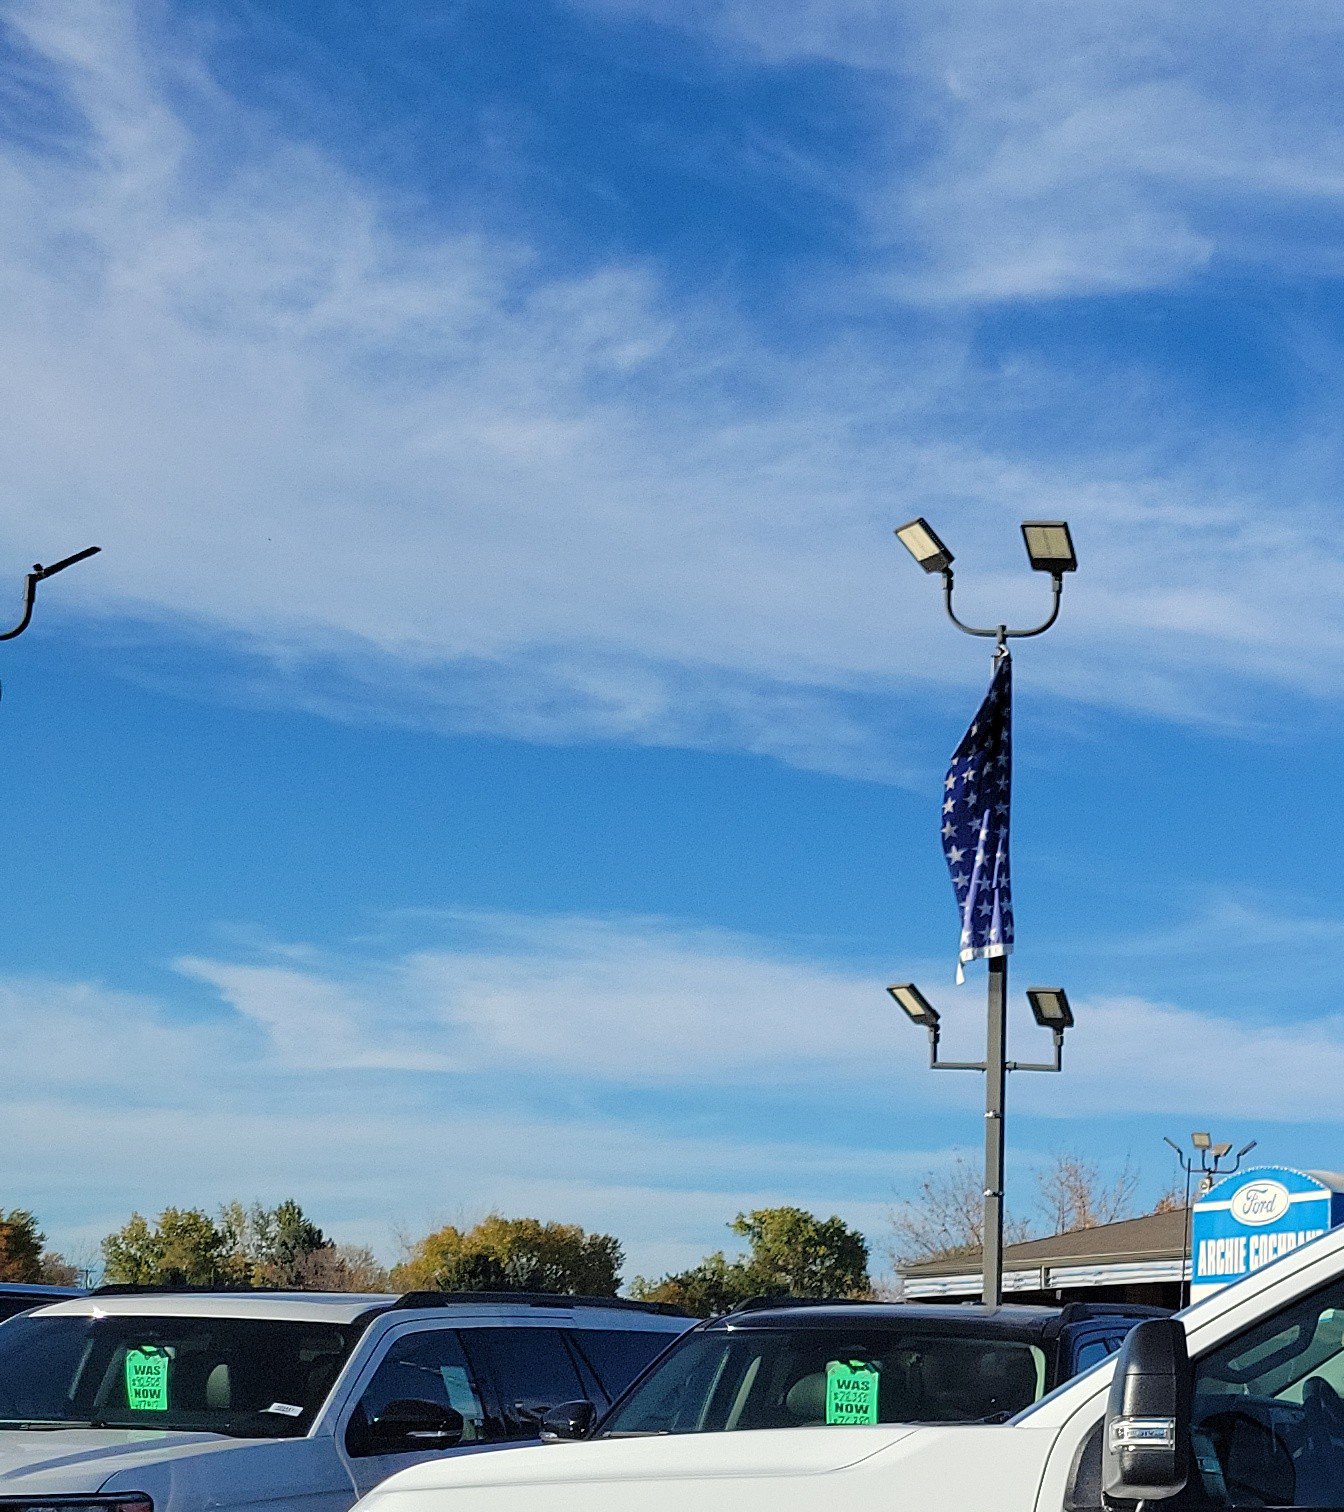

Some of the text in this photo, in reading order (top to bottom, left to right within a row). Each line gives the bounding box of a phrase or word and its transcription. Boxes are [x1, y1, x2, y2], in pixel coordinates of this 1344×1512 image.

[1242, 1188, 1278, 1215] Ford
[1197, 1236, 1247, 1277] ARCHIE
[133, 1365, 161, 1376] WAS
[836, 1379, 870, 1391] WAS
[133, 1388, 162, 1399] NOW
[834, 1402, 870, 1414] NOW
